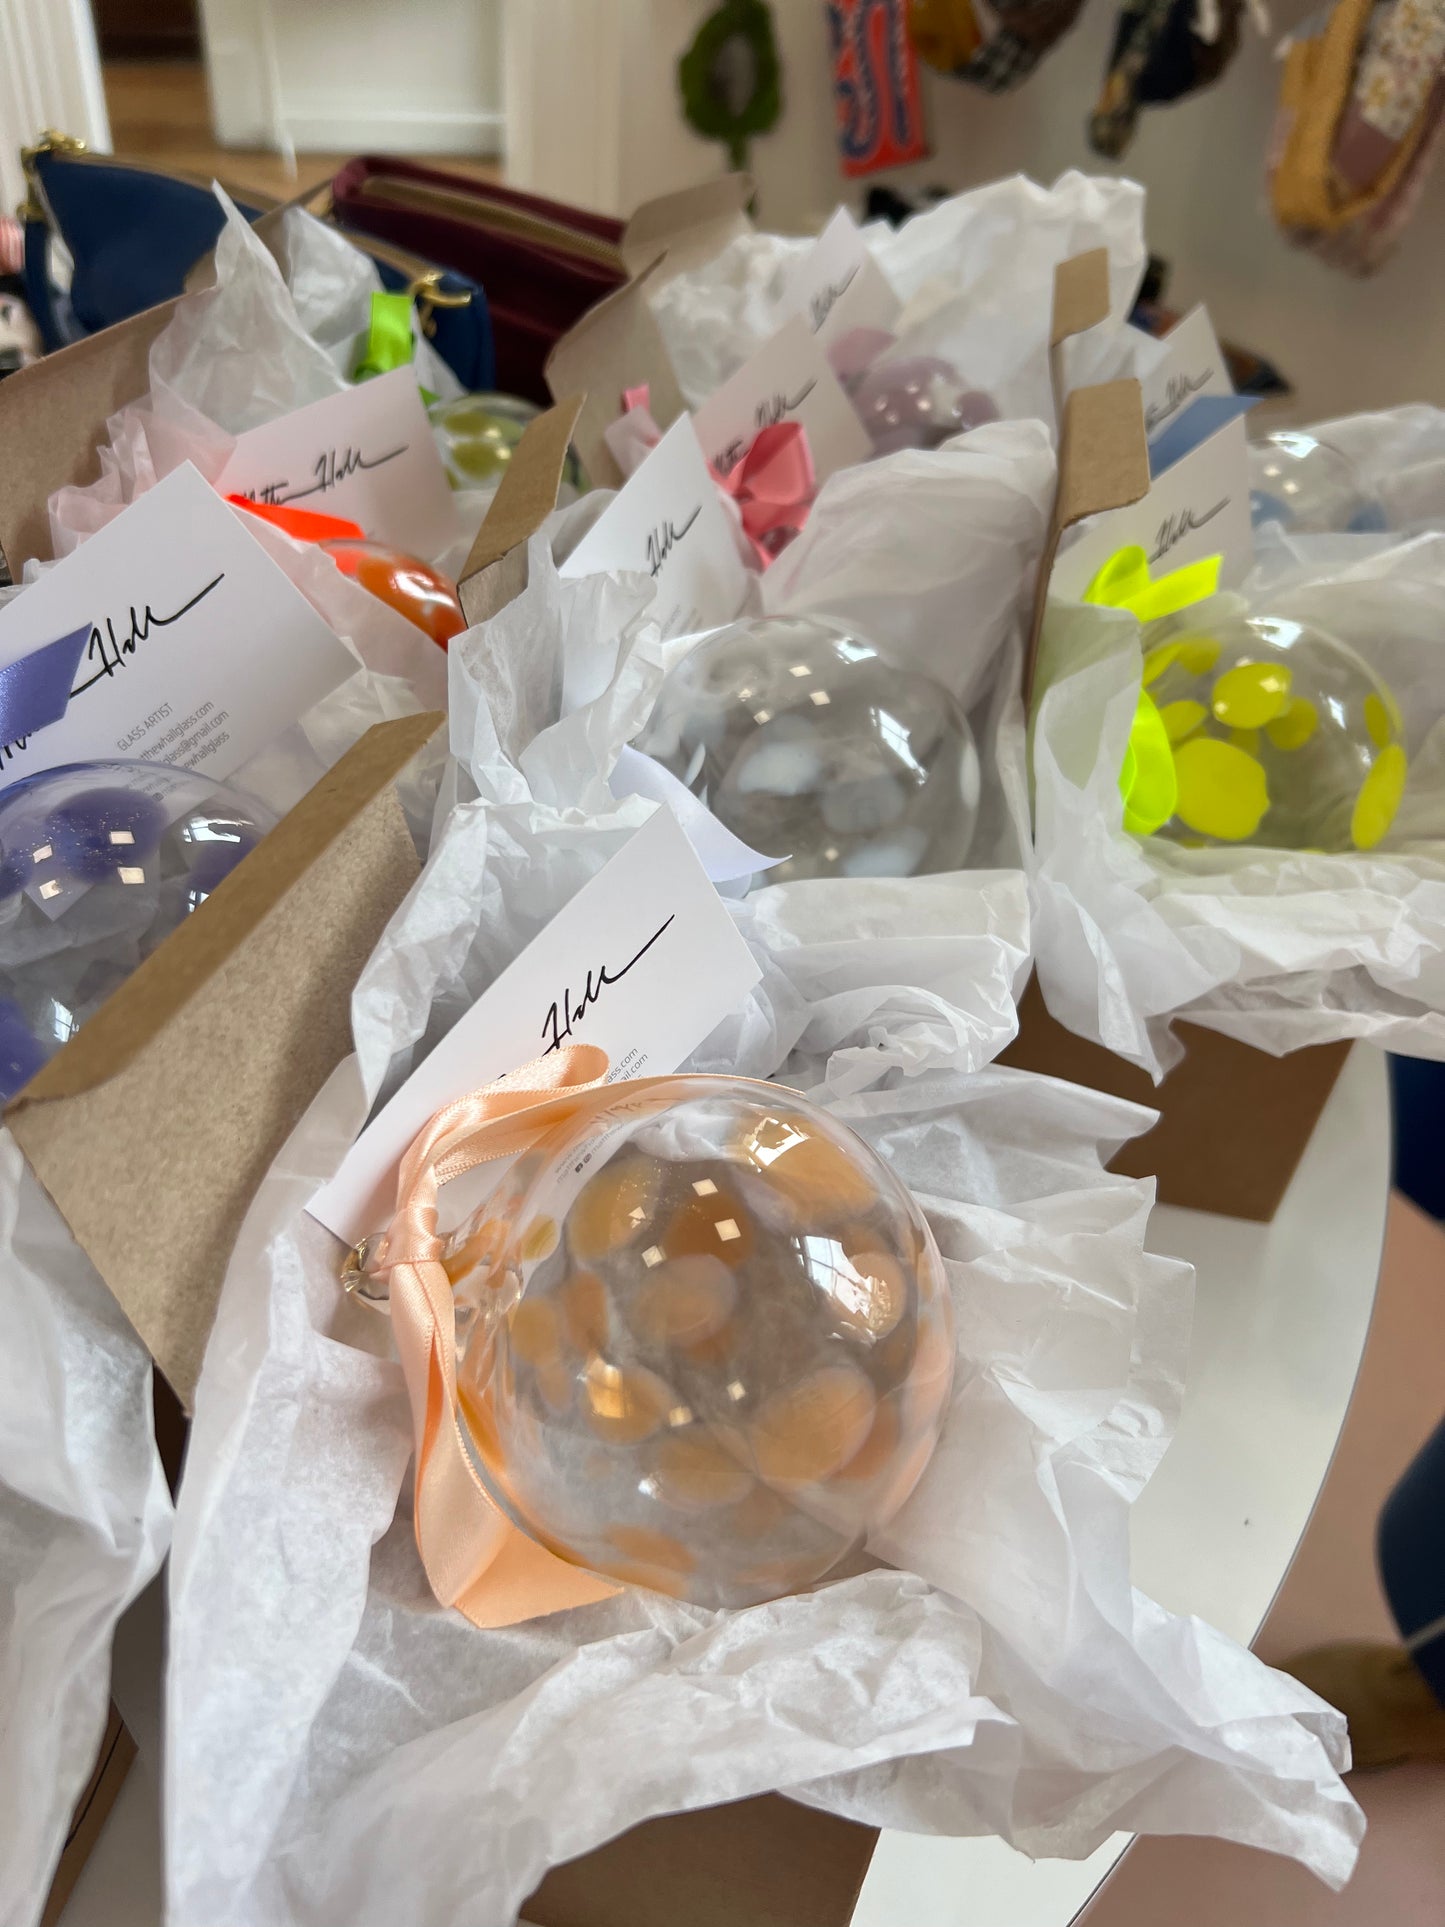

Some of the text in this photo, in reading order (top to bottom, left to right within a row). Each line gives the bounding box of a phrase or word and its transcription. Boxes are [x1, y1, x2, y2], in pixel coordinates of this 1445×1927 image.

[117, 702, 174, 752] GLASS ARTIST
[139, 701, 215, 761] tthewhallglass.com
[161, 710, 230, 765] glass@gmail.com
[183, 731, 231, 769] ewhallglass
[607, 1048, 639, 1084] ass.com
